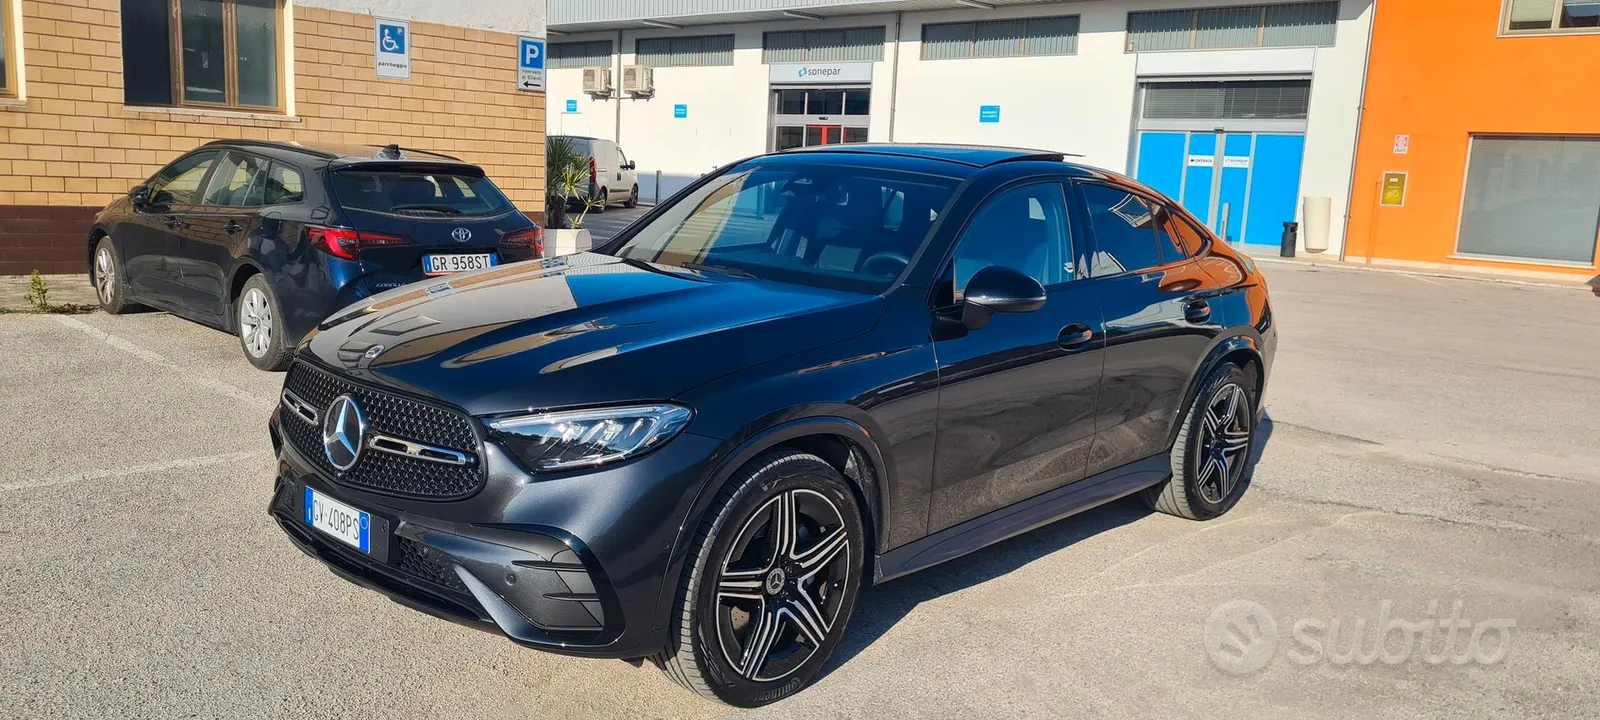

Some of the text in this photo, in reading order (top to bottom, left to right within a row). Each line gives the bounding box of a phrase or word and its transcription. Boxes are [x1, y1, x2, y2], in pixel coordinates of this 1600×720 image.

[525, 44, 540, 65] P
[377, 61, 408, 69] parcheggio
[808, 68, 841, 77] sonepar
[432, 256, 447, 271] GR
[451, 255, 489, 270] 958ST
[314, 499, 324, 523] GV
[328, 508, 359, 540] 408PS
